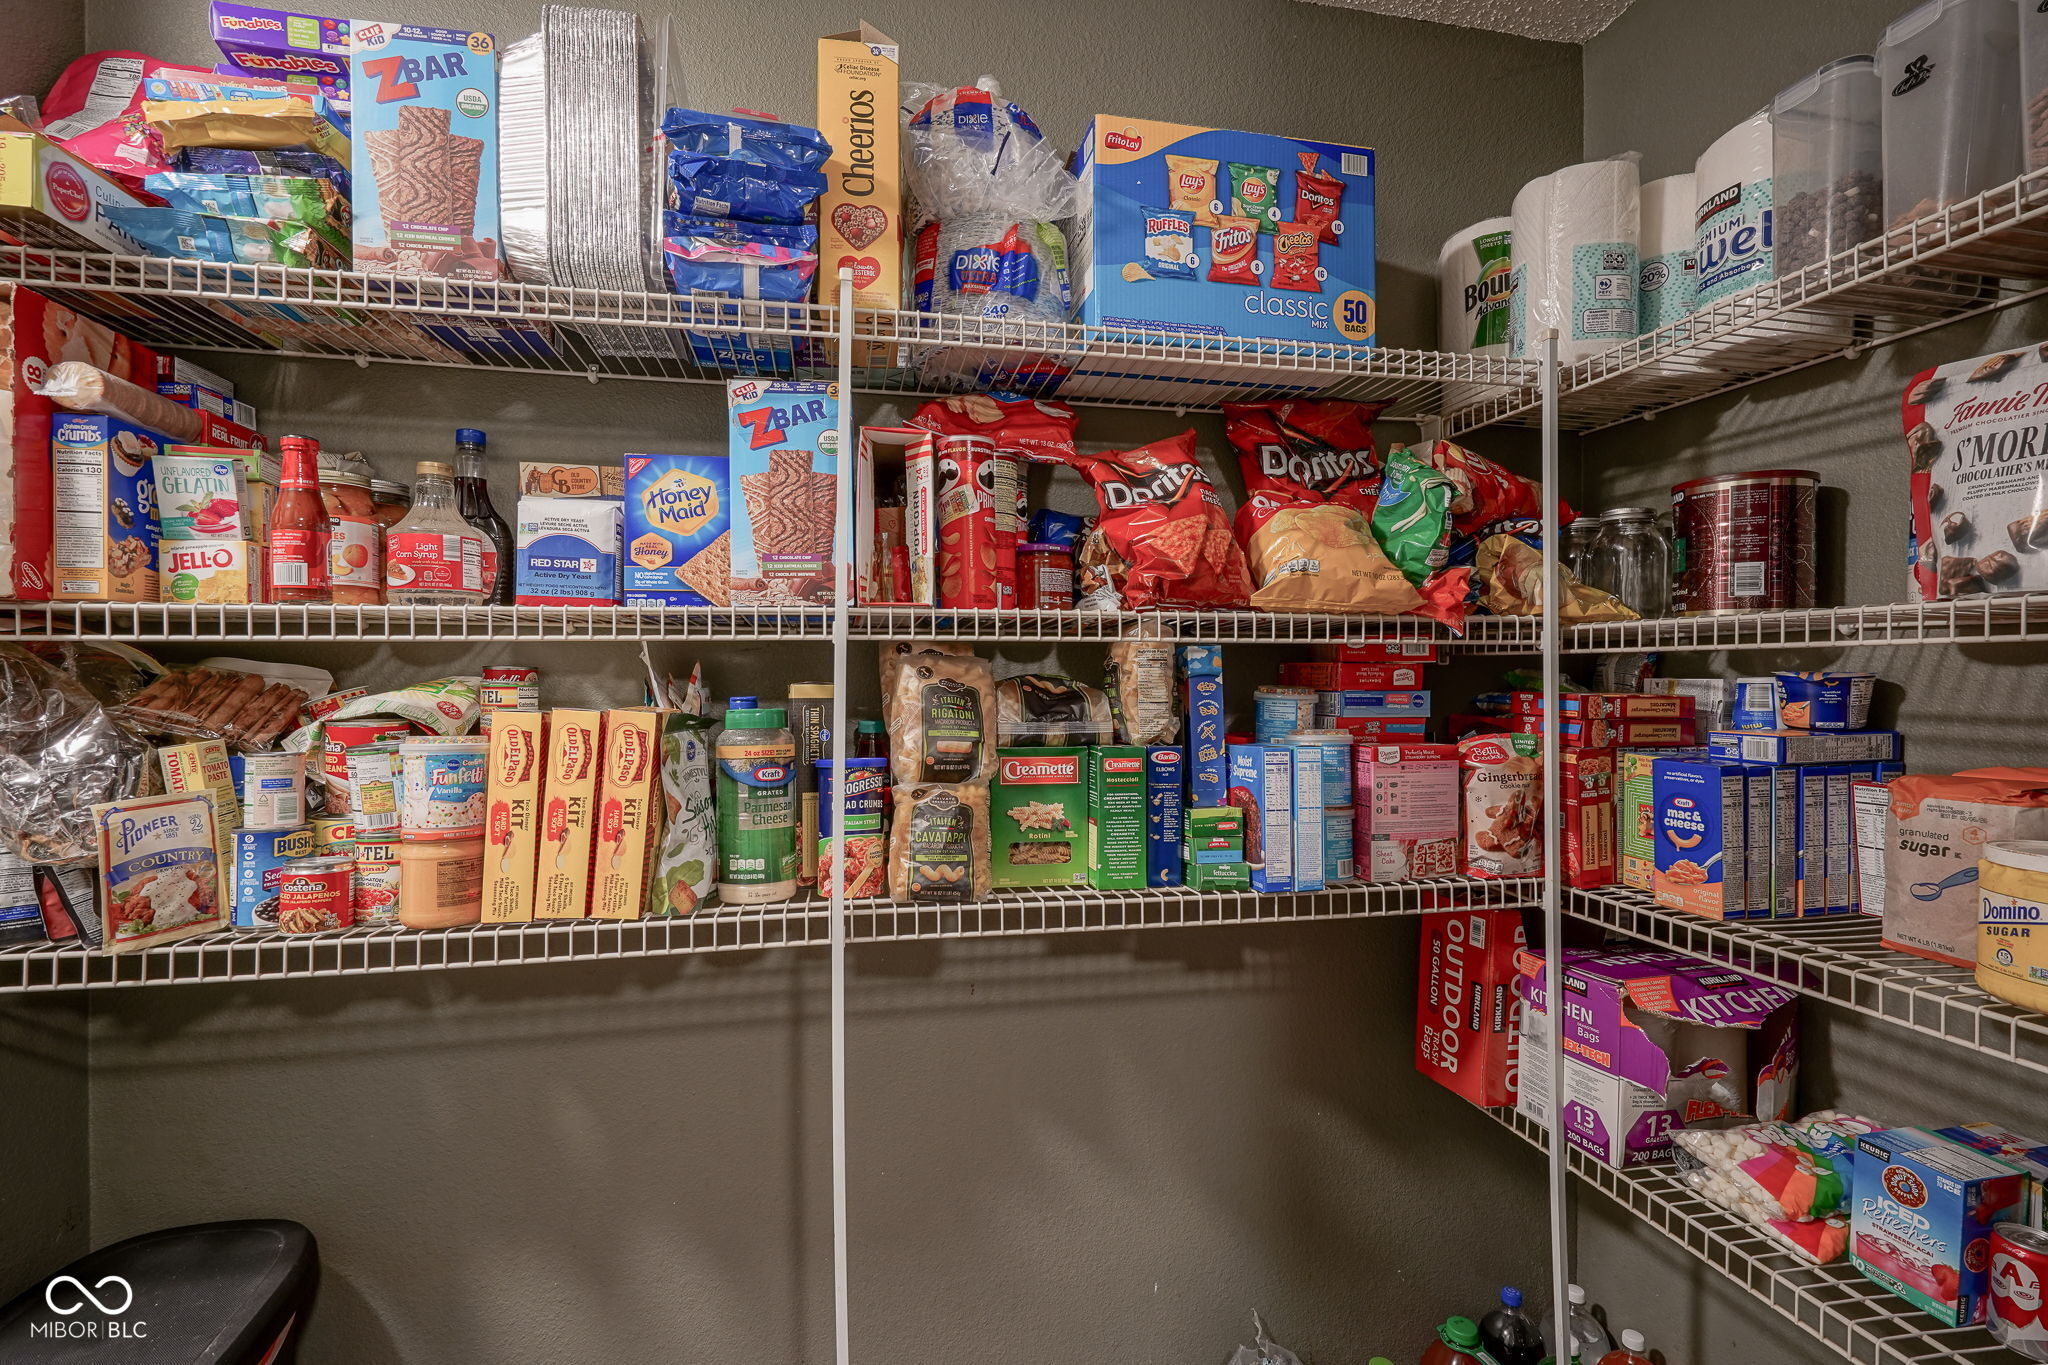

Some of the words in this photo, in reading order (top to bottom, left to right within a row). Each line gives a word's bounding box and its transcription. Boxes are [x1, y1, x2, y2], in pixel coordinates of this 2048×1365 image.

[220, 15, 282, 31] Funables
[359, 24, 383, 39] CLIF
[471, 36, 490, 49] 36
[232, 52, 340, 75] Funables
[843, 63, 858, 71] Celiac
[463, 94, 482, 104] USDA
[842, 89, 875, 197] Cheerios
[1179, 174, 1206, 189] Lay's
[1241, 182, 1267, 198] Lay's
[1301, 189, 1334, 206] Doritos
[1213, 203, 1220, 212] 6
[1148, 218, 1189, 234] RUFFLES
[1334, 223, 1342, 233] 10
[1215, 227, 1252, 249] Fritos
[1277, 232, 1313, 254] Cheetos
[960, 269, 997, 283] ULTRA
[1639, 270, 1667, 285] 20%
[1244, 290, 1329, 320] classic
[1343, 299, 1367, 325] 50
[1311, 319, 1329, 330] MIX
[1344, 323, 1367, 334] BAGS
[26, 363, 43, 387] 18
[735, 382, 757, 397] CLIF
[1944, 390, 2033, 430] Fannie
[57, 427, 102, 443] Crumbs
[211, 428, 230, 442] REAL
[56, 450, 87, 458] Nutrition
[88, 450, 103, 458] Facts
[56, 467, 84, 475] Calories
[85, 466, 103, 475] 130
[160, 466, 212, 478] UNFLAVORED
[1260, 444, 1370, 488] Doritos
[161, 476, 230, 495] GELATIN
[1104, 460, 1213, 511] Doritos
[649, 483, 712, 511] Honey
[658, 500, 707, 524] Maid
[912, 490, 921, 557] POPCORN
[415, 542, 439, 552] Light
[633, 546, 669, 559] Honey
[395, 550, 413, 559] Corn
[413, 550, 439, 561] Syrup
[530, 558, 551, 568] RED
[553, 559, 579, 569] STAR
[533, 572, 554, 580] Active
[556, 572, 569, 581] Dry
[570, 573, 593, 581] Yeast
[634, 571, 644, 581] NO
[529, 587, 539, 596] 32
[558, 588, 572, 597] lbs)
[574, 589, 589, 597] 908
[940, 696, 966, 706] ITALIAN
[810, 706, 820, 724] THIN
[931, 709, 975, 721] RIGATONI
[1514, 738, 1536, 746] LIMITED
[744, 749, 751, 757] 24
[1157, 753, 1178, 762] Barilla
[1474, 746, 1499, 758] Betty
[202, 760, 230, 774] TOMATO
[1105, 761, 1141, 770] Creamette
[1237, 755, 1254, 768] Moist
[431, 767, 485, 787] Funfetti
[761, 769, 783, 779] Kraft
[1003, 760, 1075, 779] Creamette
[1232, 764, 1259, 780] Supreme
[207, 771, 229, 784] PASTE
[1106, 776, 1139, 784] Mostaccioli
[436, 786, 463, 796] Vanilla
[757, 789, 784, 797] GRATED
[843, 776, 884, 798] OGRESSO
[743, 799, 793, 814] Parmesan
[859, 799, 884, 810] CRUMBS
[1676, 799, 1691, 808] Kraft
[510, 799, 525, 830] KIT
[567, 796, 582, 828] KIT
[622, 798, 637, 829] KIT
[751, 813, 789, 826] Cheese
[1667, 808, 1692, 821] mac
[1691, 811, 1703, 822] &
[190, 816, 204, 834] 2
[929, 816, 956, 827] ITALIAN
[116, 814, 179, 856] PIONEER
[162, 826, 180, 835] since
[914, 831, 968, 844] CAVATAPPI
[1029, 832, 1053, 841] Rotini
[1898, 826, 1950, 843] granulated
[276, 835, 316, 854] BUSH'S
[1898, 838, 1951, 859] sugar
[294, 848, 308, 857] BEST
[128, 849, 206, 873] COUNTRY
[295, 877, 306, 887] La
[291, 889, 342, 901] JALAPEÑOS
[1693, 886, 1720, 900] original
[1697, 893, 1720, 907] flavor
[1983, 896, 2041, 922] Domino
[1986, 925, 2032, 939] SUGAR
[1431, 939, 1441, 955] 50
[1430, 955, 1440, 1006] GALLON
[1699, 973, 1744, 986] KIRKLAND
[1439, 918, 1465, 1075] OUTDOOR
[1680, 984, 1800, 1022] KITCHEN
[1471, 983, 1482, 1031] KIRKLAND
[1493, 984, 1504, 1032] KIRKLAND
[1530, 986, 1593, 1026] KITHEN
[1577, 1026, 1600, 1043] Bags
[1421, 1024, 1434, 1061] Bags
[1431, 1031, 1440, 1067] TRASH
[1573, 1105, 1595, 1130] 13
[1573, 1122, 1595, 1137] GALLON
[1646, 1114, 1672, 1137] 13
[1567, 1129, 1582, 1145] 200
[1582, 1136, 1605, 1158] BAGS
[1859, 1141, 1891, 1160] KEURIG
[1632, 1151, 1651, 1163] 200
[1943, 1184, 1962, 1196] ICE
[1877, 1194, 1931, 1232] ICED
[1861, 1197, 1948, 1254] Refreshers
[1871, 1222, 1916, 1250] STRAWBERRY
[1916, 1246, 1935, 1258] ACAI
[1851, 1255, 1866, 1271] 10
[1959, 1296, 1967, 1325] KEURIG
